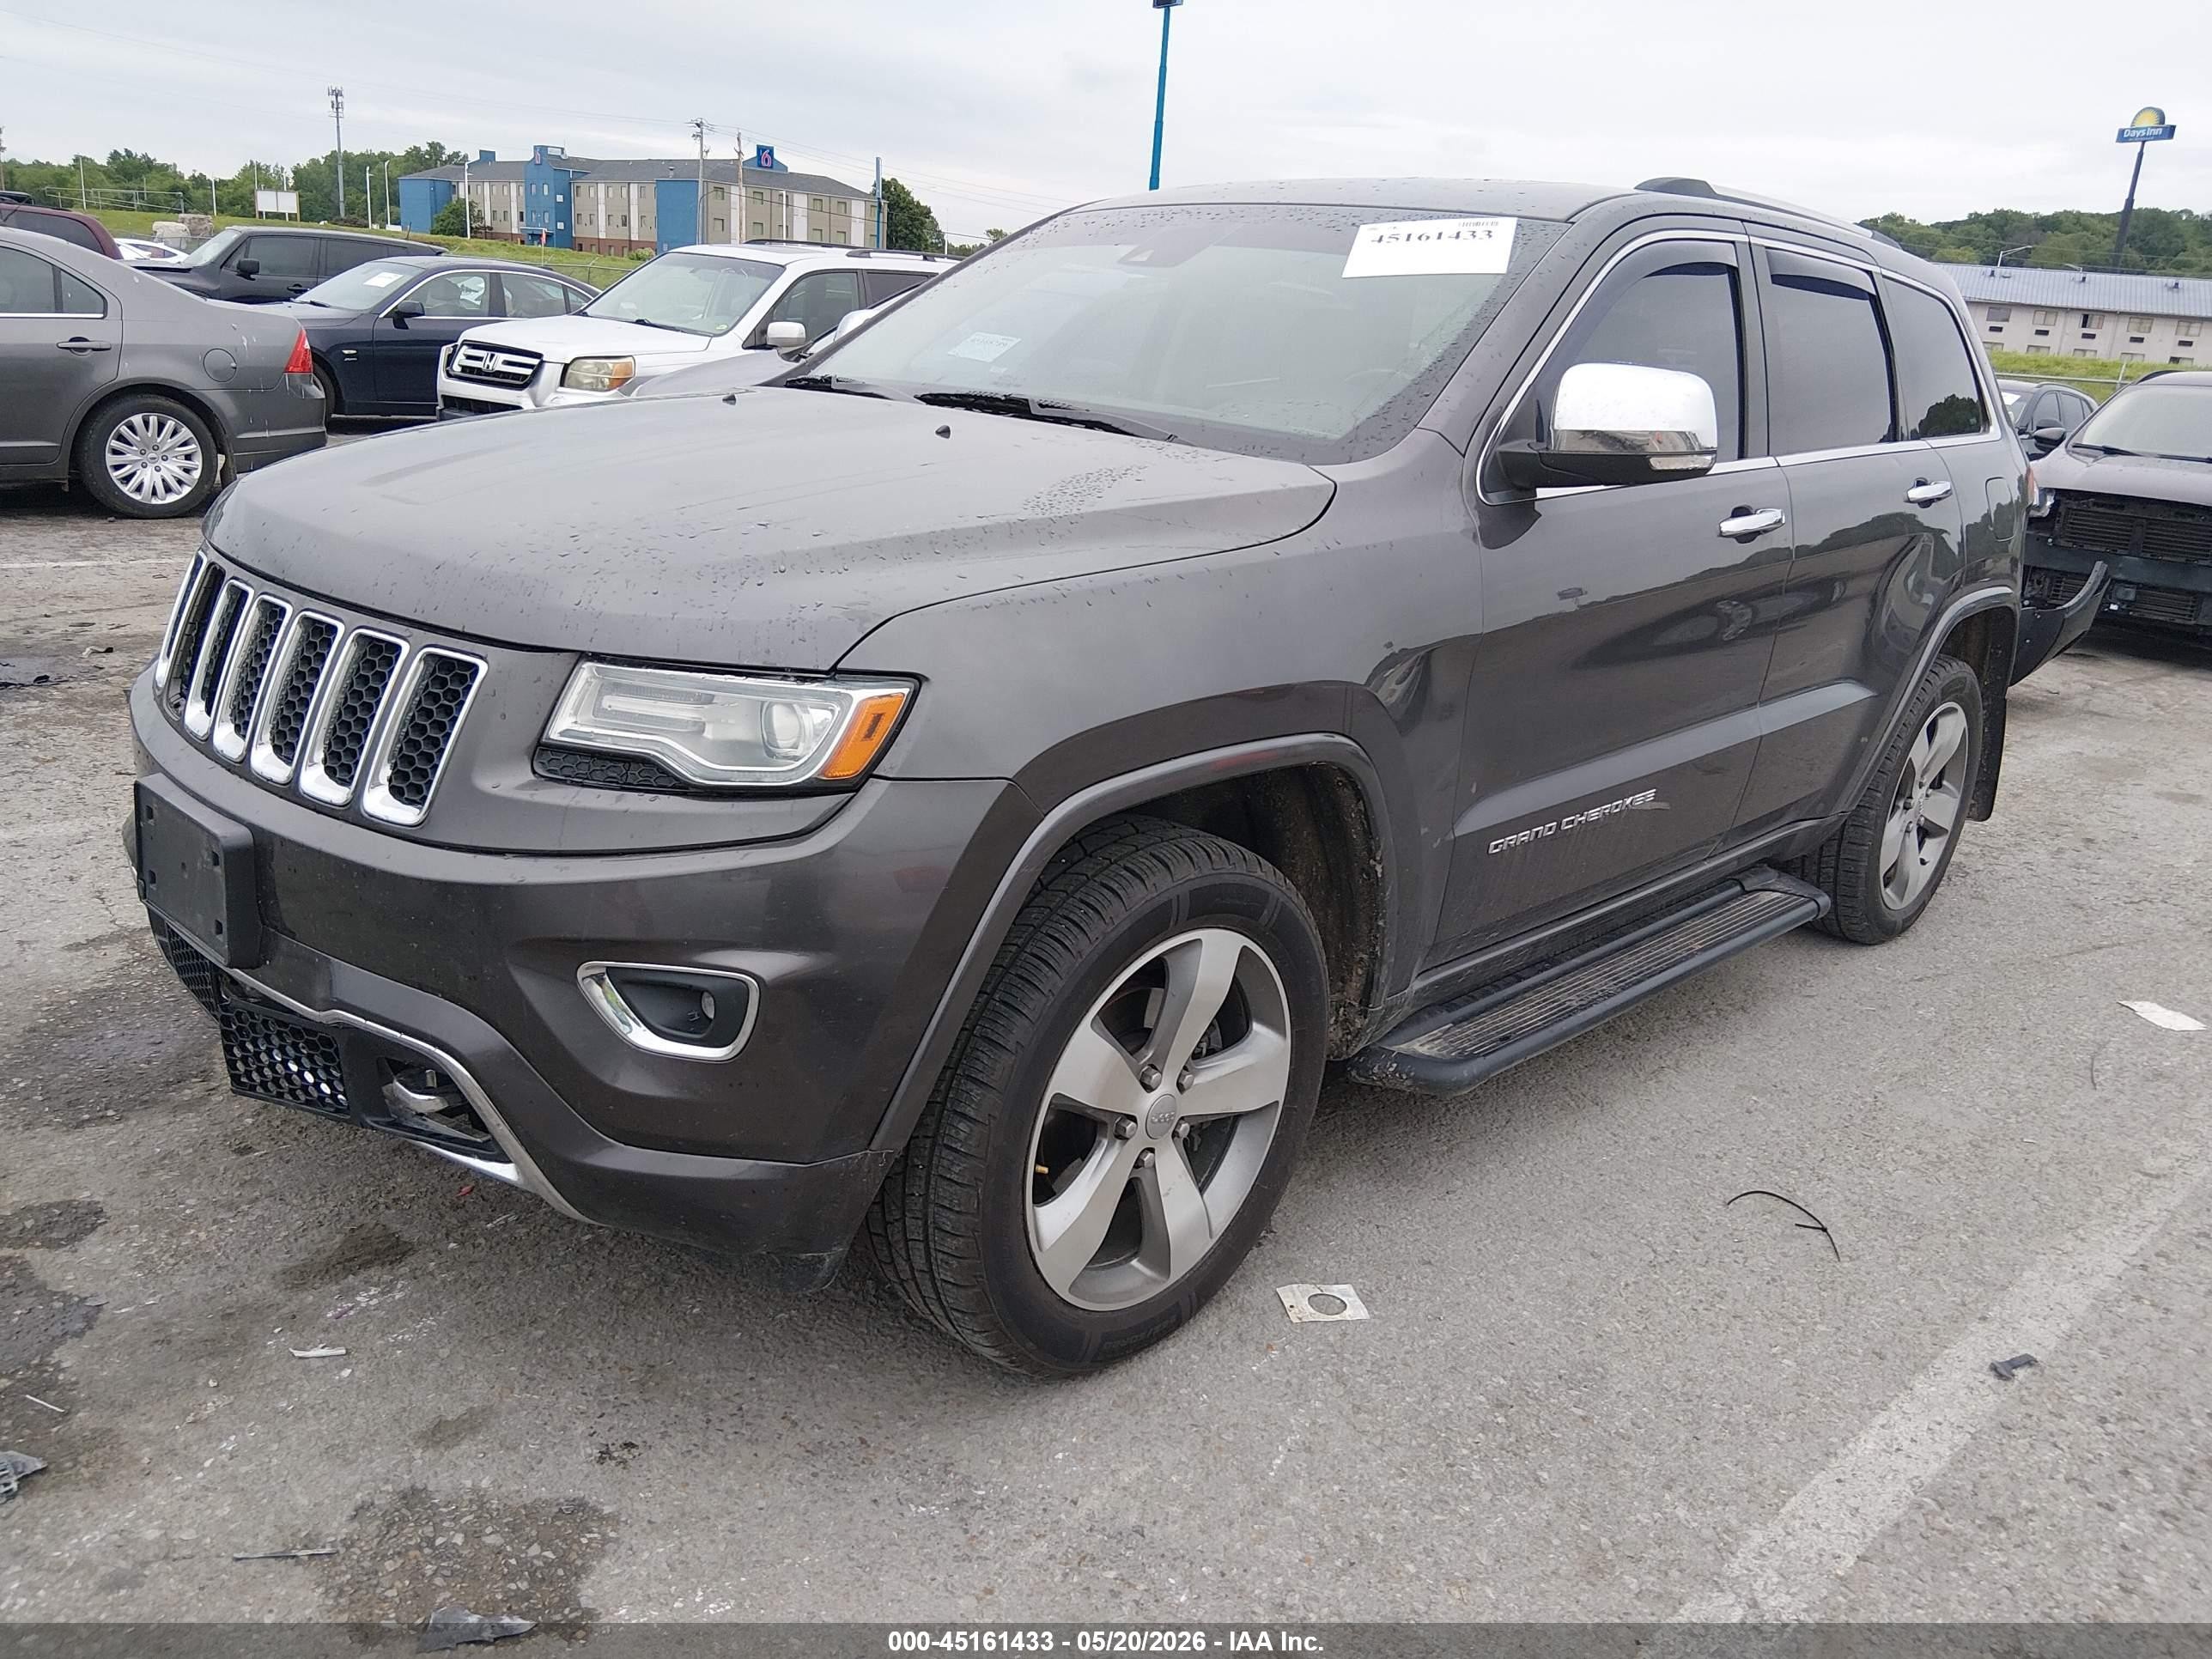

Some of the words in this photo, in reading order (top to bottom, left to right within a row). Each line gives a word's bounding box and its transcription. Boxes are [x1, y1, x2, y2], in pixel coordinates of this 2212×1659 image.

[761, 149, 772, 167] 6
[1370, 229, 1493, 244] 45161433
[1488, 821, 1558, 854] GRAND
[1560, 788, 1657, 830] CHEROKEE
